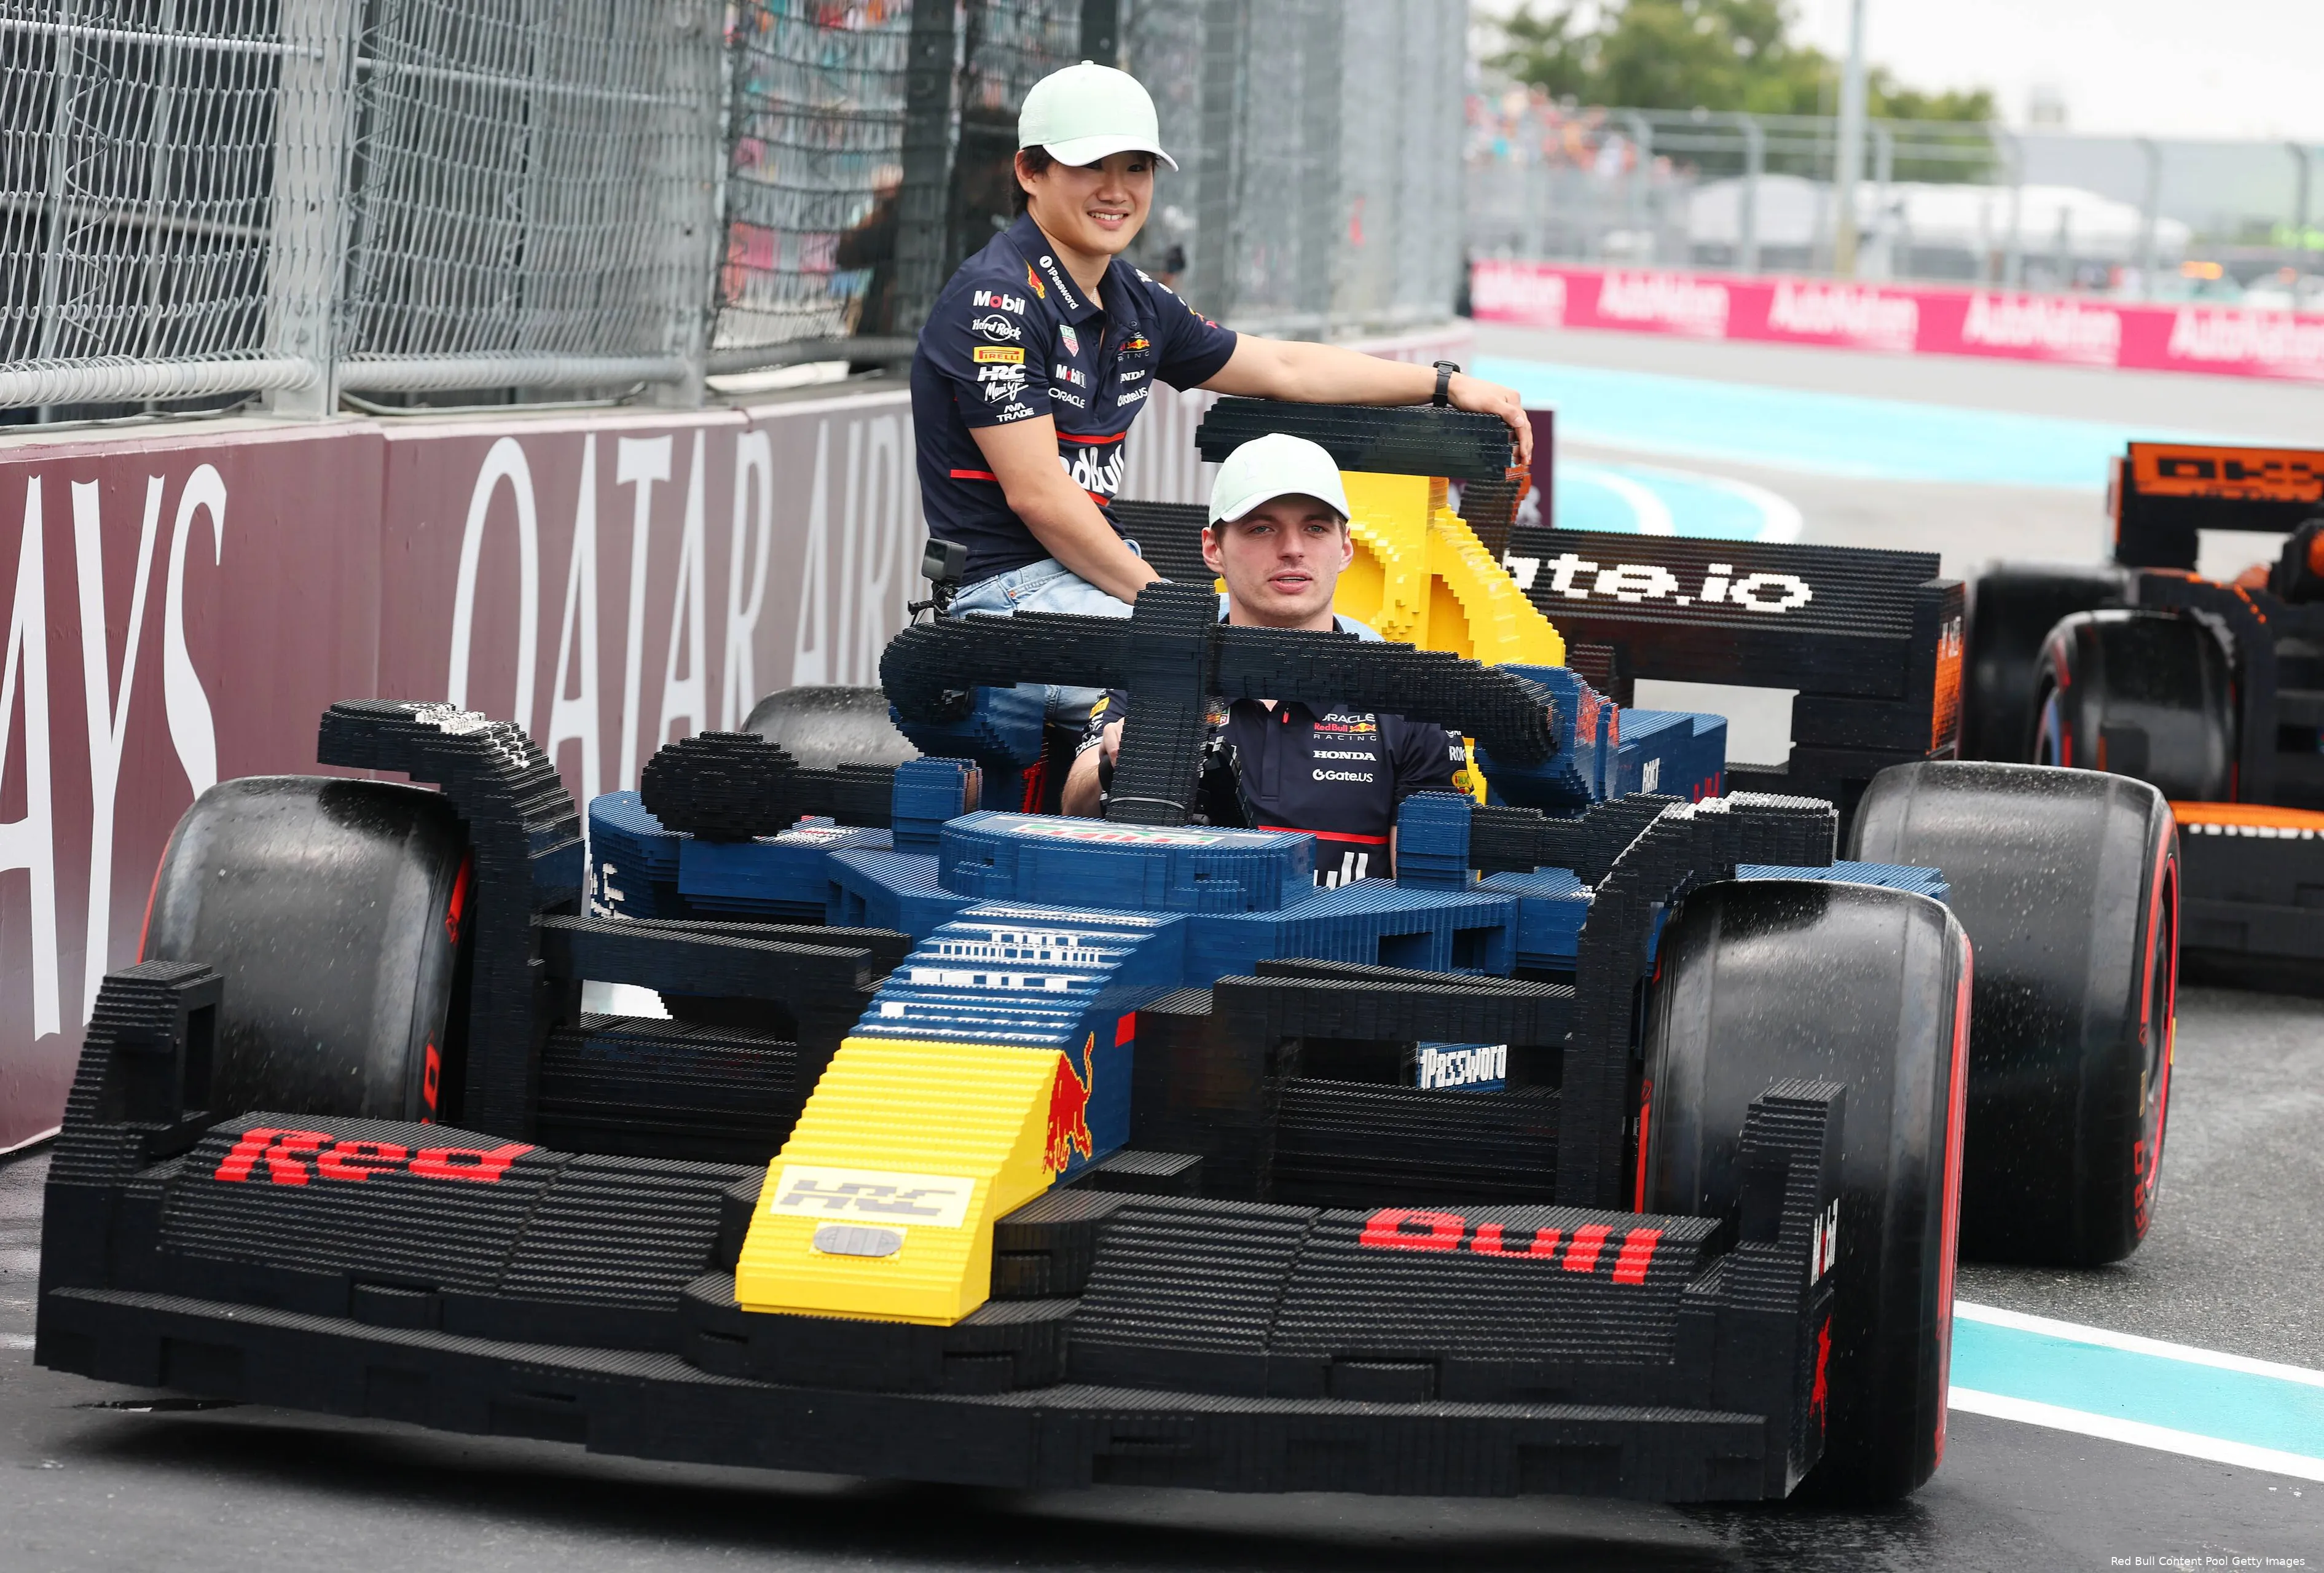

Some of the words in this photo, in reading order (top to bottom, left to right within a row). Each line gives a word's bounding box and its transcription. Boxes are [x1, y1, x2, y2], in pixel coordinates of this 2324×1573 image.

[1047, 266, 1080, 309] 1Password
[973, 290, 1026, 315] Mobil
[972, 319, 998, 332] Hard
[996, 323, 1021, 340] Rock
[979, 350, 1019, 361] PIRELLI
[977, 364, 1026, 382] HRC
[1056, 364, 1080, 385] Mobil
[1004, 402, 1026, 414] AVA
[1048, 388, 1086, 409] ORACLE
[996, 407, 1035, 422] TRADE
[1314, 722, 1330, 731] Red
[1332, 723, 1348, 732] Bull
[1313, 750, 1376, 761] HONDA
[1325, 770, 1373, 783] Gate.US
[1419, 1044, 1507, 1089] 1Password
[214, 1127, 536, 1184] Red
[779, 1179, 957, 1217] HRC
